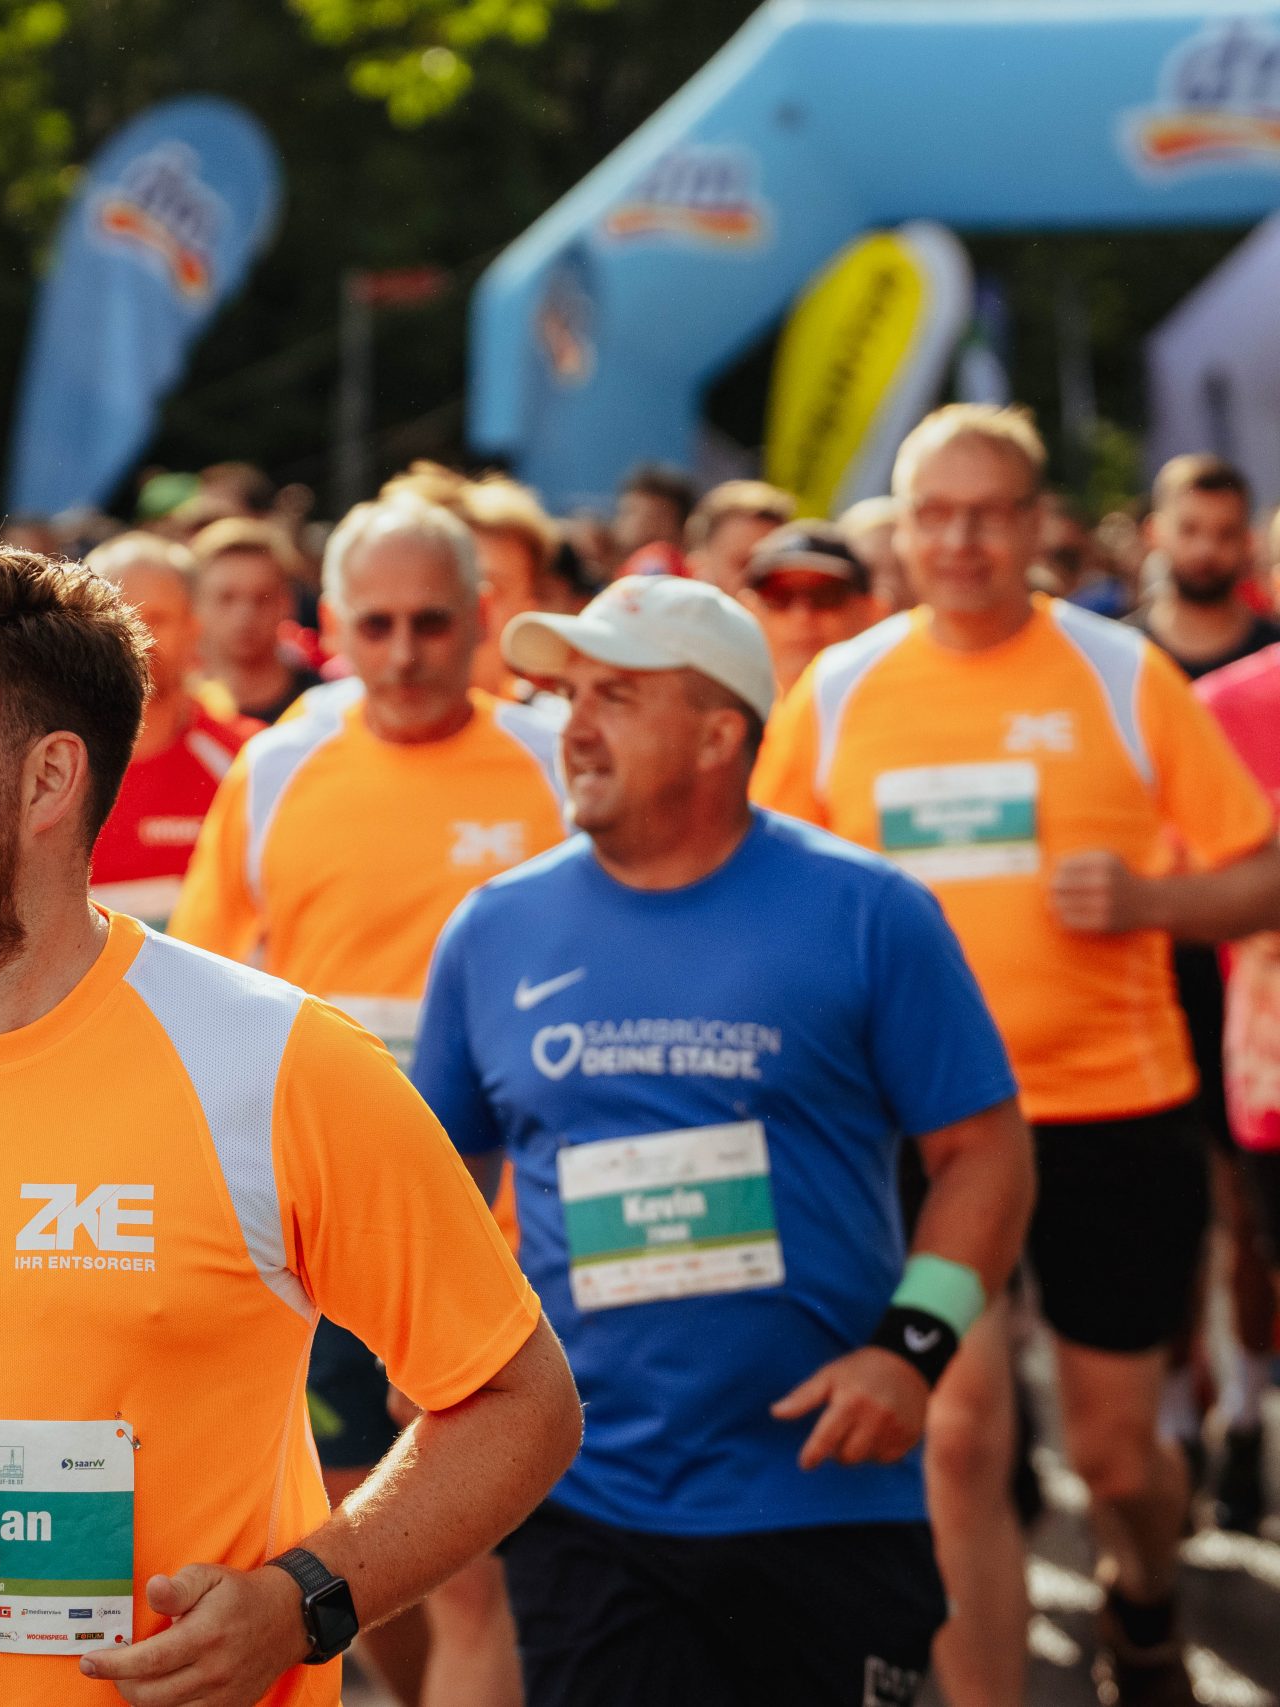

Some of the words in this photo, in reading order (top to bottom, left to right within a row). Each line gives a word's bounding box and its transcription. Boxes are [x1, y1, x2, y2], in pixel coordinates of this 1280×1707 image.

[583, 1018, 781, 1055] SAARBRÜCKEN
[581, 1046, 663, 1077] DEINE
[16, 1183, 155, 1253] ZKE
[15, 1256, 43, 1270] IHR
[48, 1256, 156, 1272] ENTSORGER
[26, 1633, 69, 1641] WOCHENSPIEGEL
[76, 1632, 104, 1640] FORUM
